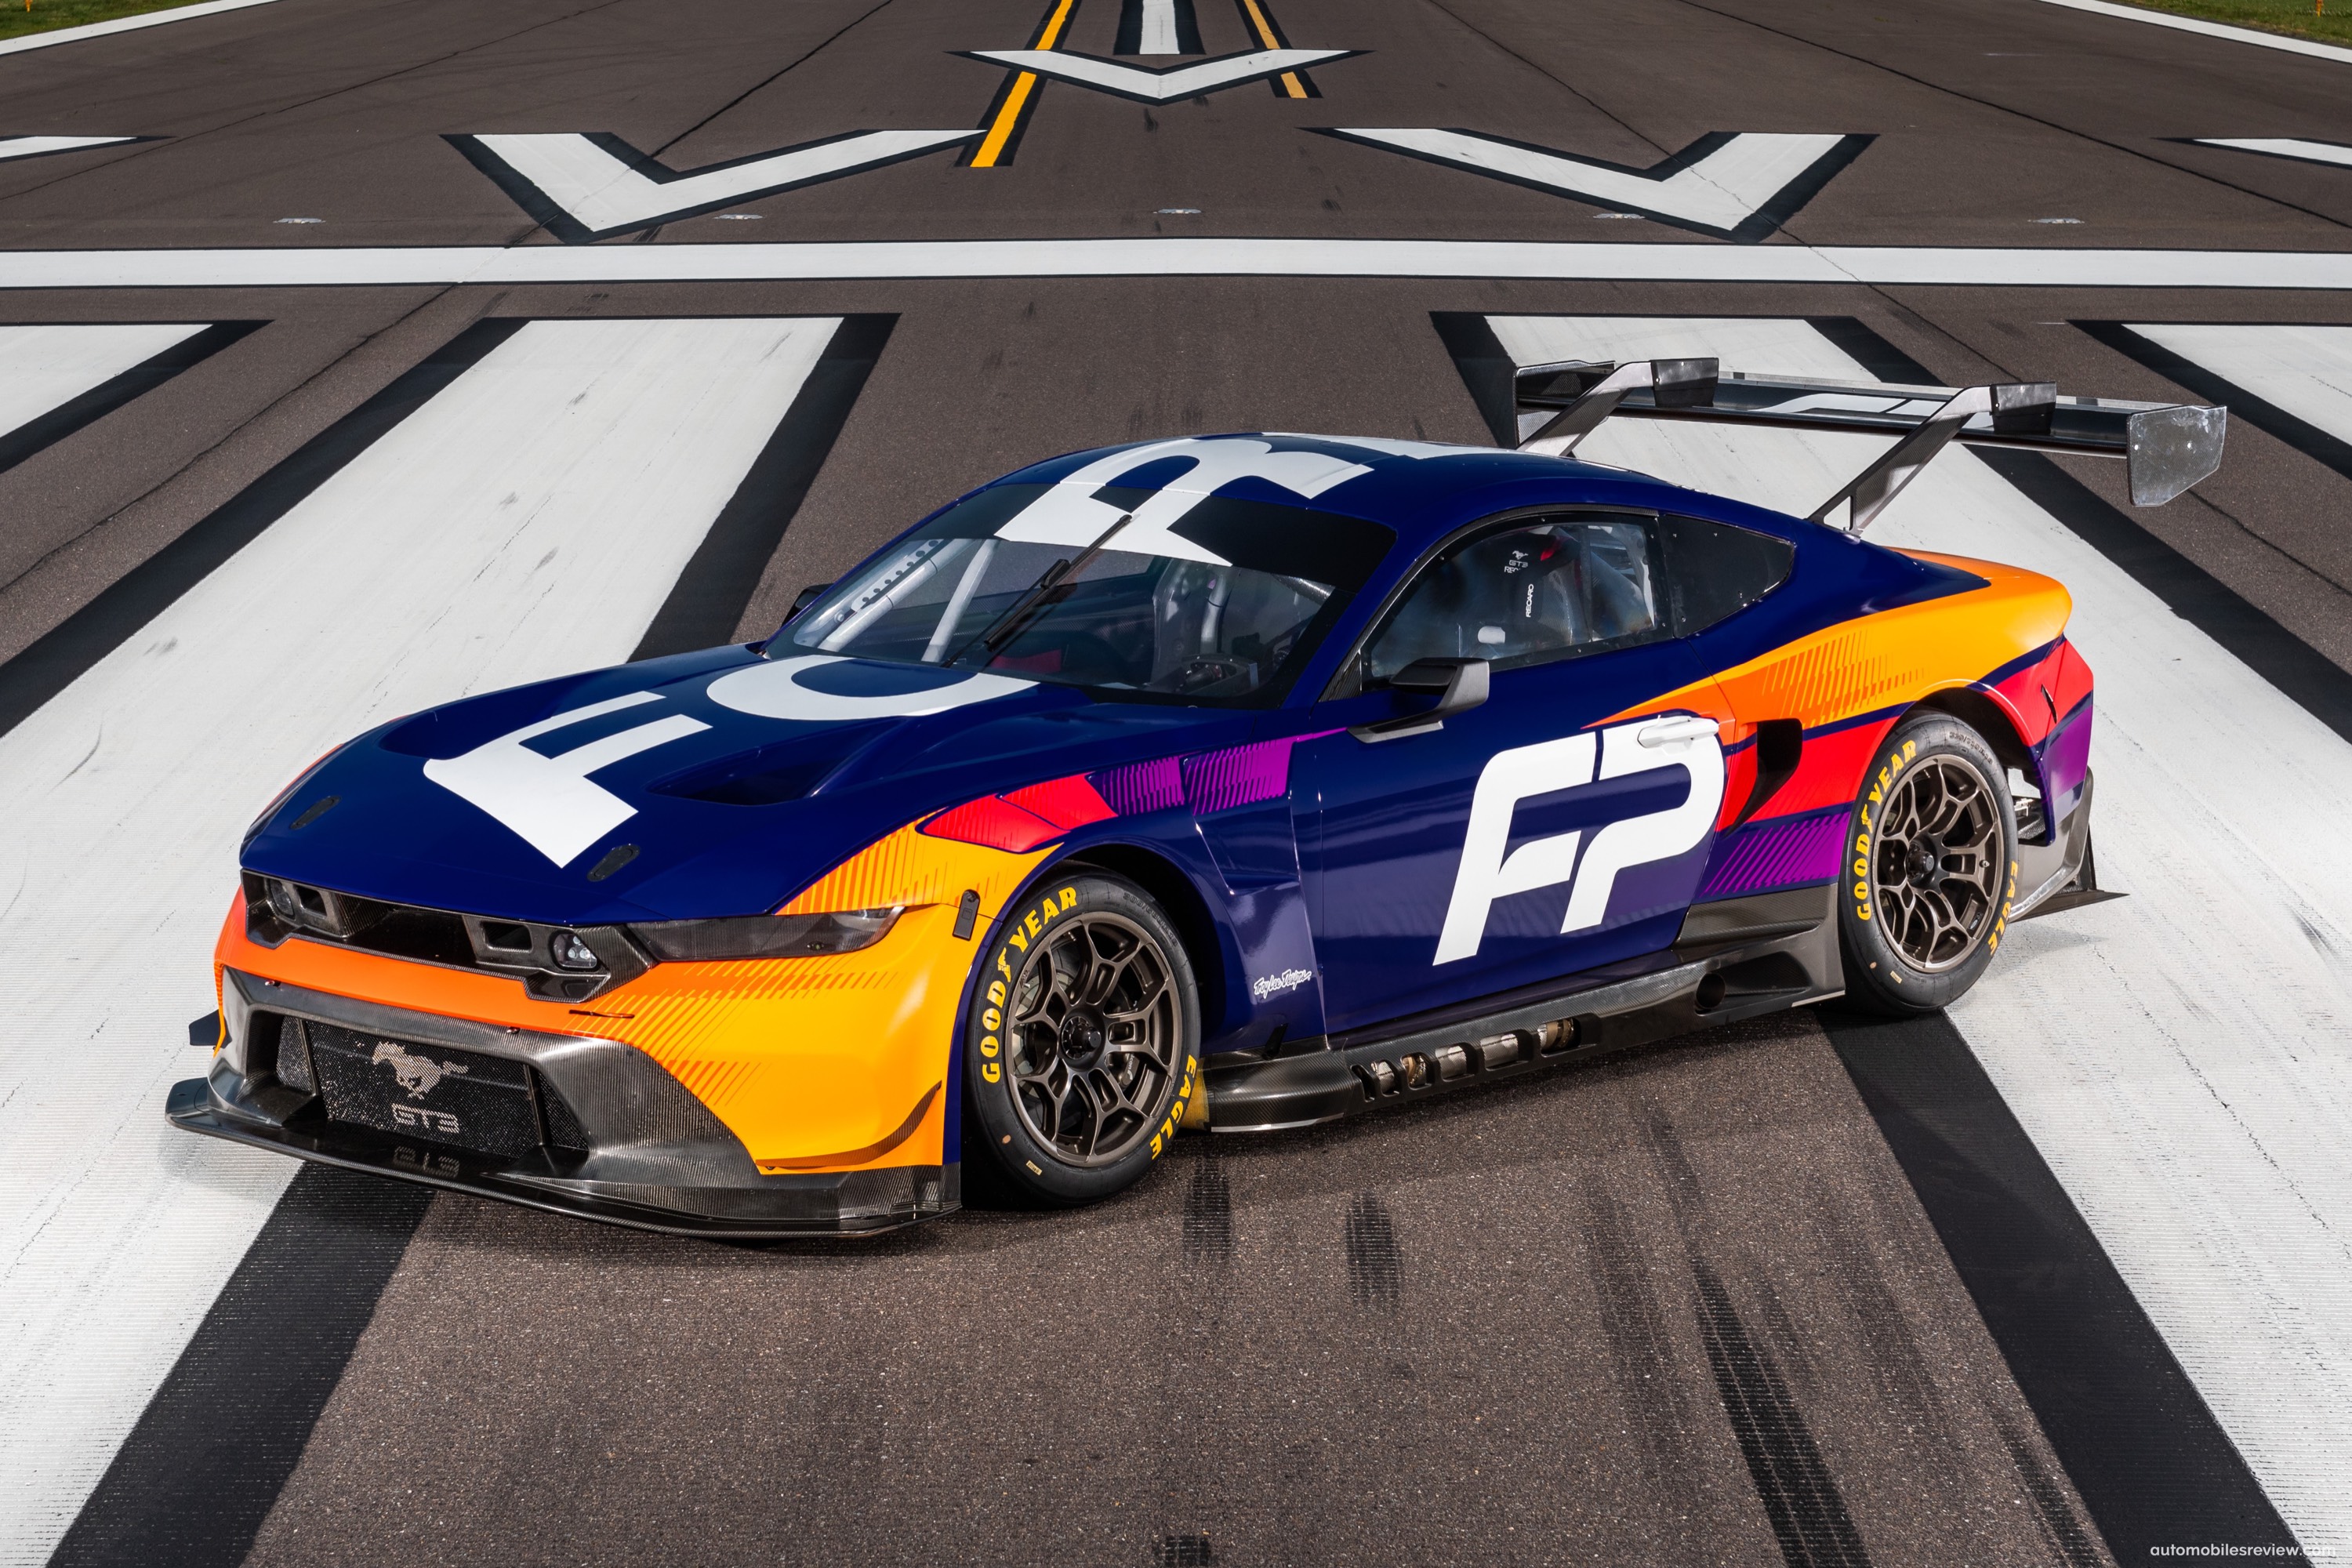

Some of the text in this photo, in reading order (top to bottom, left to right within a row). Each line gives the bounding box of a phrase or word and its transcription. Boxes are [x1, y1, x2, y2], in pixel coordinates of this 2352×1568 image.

[1508, 559, 1529, 568] GT3
[1525, 583, 1534, 618] RECARO
[1434, 713, 1721, 966] FP
[1853, 739, 1917, 920] GOODYEAR
[1987, 860, 2019, 956] EAGLE
[980, 886, 1078, 1083] GOODYEAR
[392, 1102, 460, 1134] GT3
[1149, 1054, 1197, 1160] EAGLE
